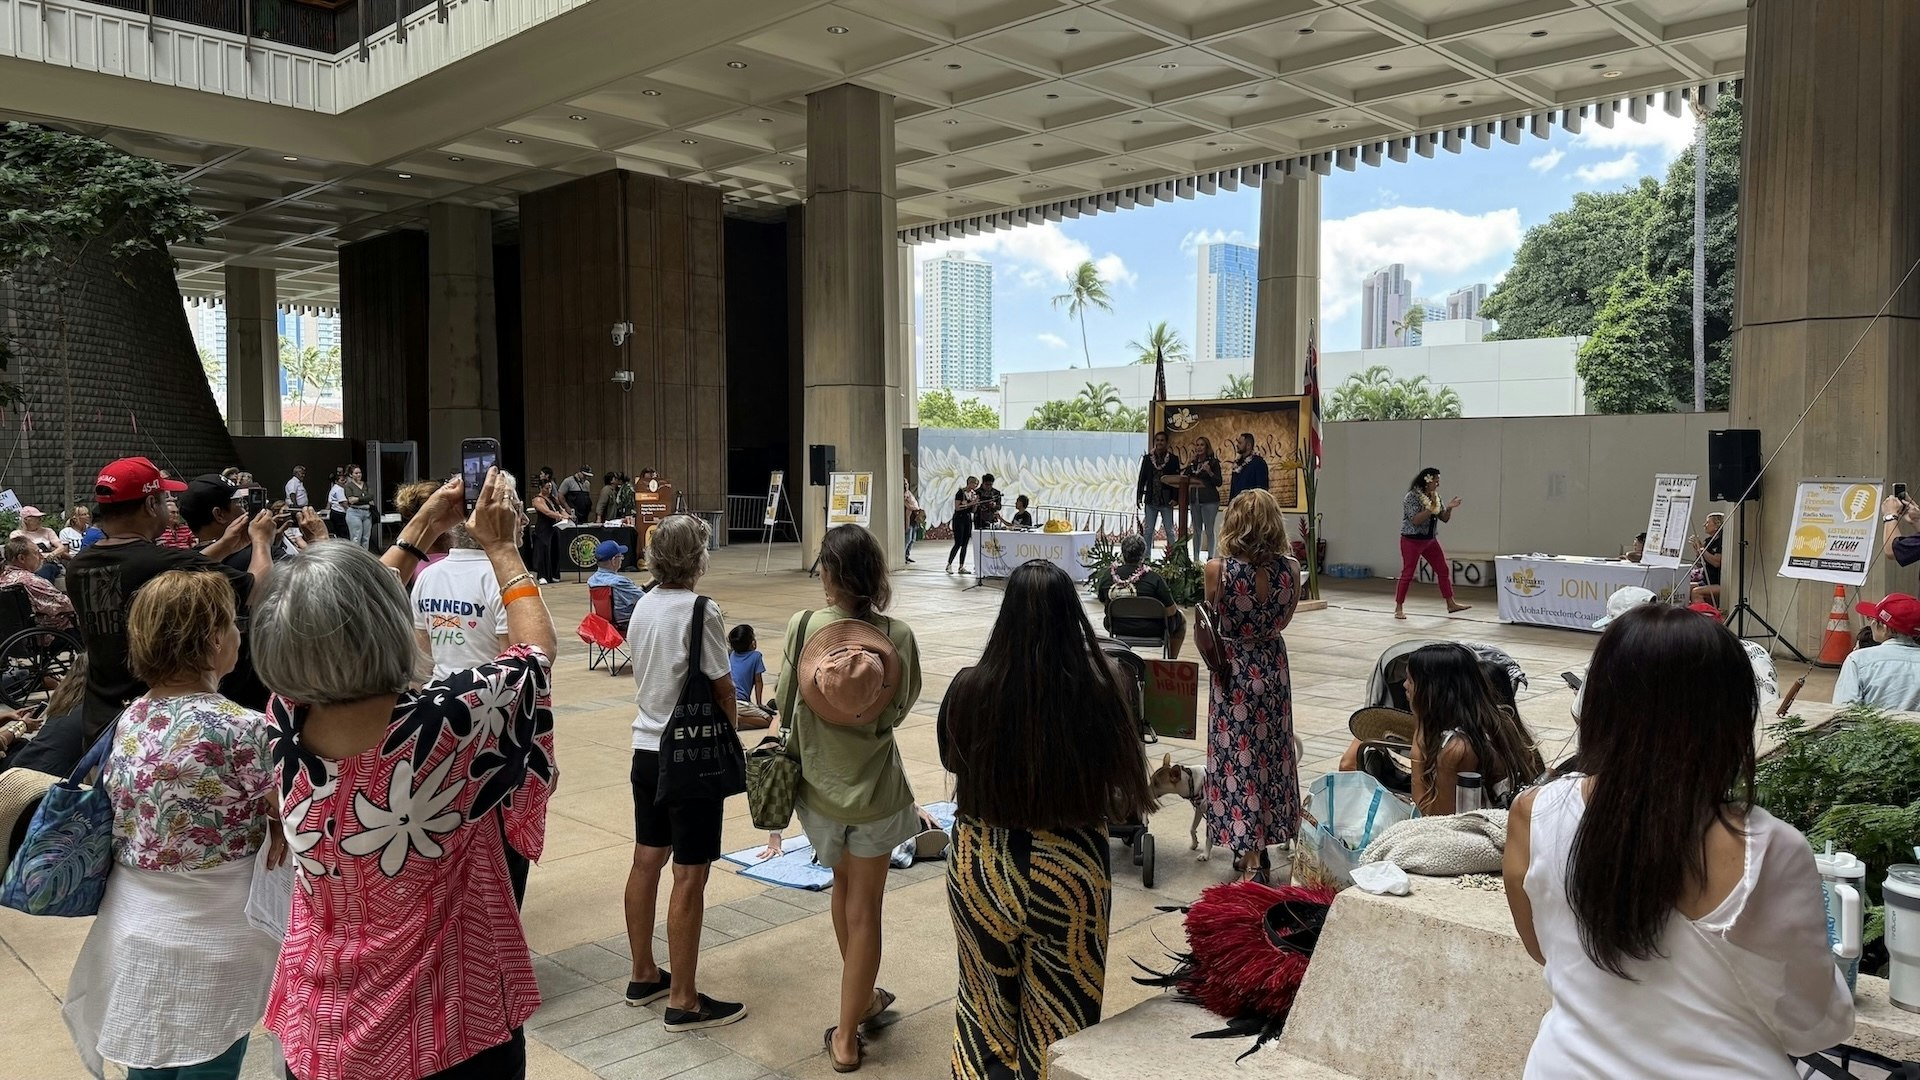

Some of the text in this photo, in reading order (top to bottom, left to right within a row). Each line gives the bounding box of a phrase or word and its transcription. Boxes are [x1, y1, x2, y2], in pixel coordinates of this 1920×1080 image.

[1015, 543, 1041, 558] JOIN
[1044, 544, 1064, 560] US!
[1830, 540, 1860, 551] KHVH
[1557, 578, 1598, 601] JOIN
[418, 598, 485, 618] KENNEDY
[431, 631, 466, 646] HHS
[1152, 661, 1195, 681] NO
